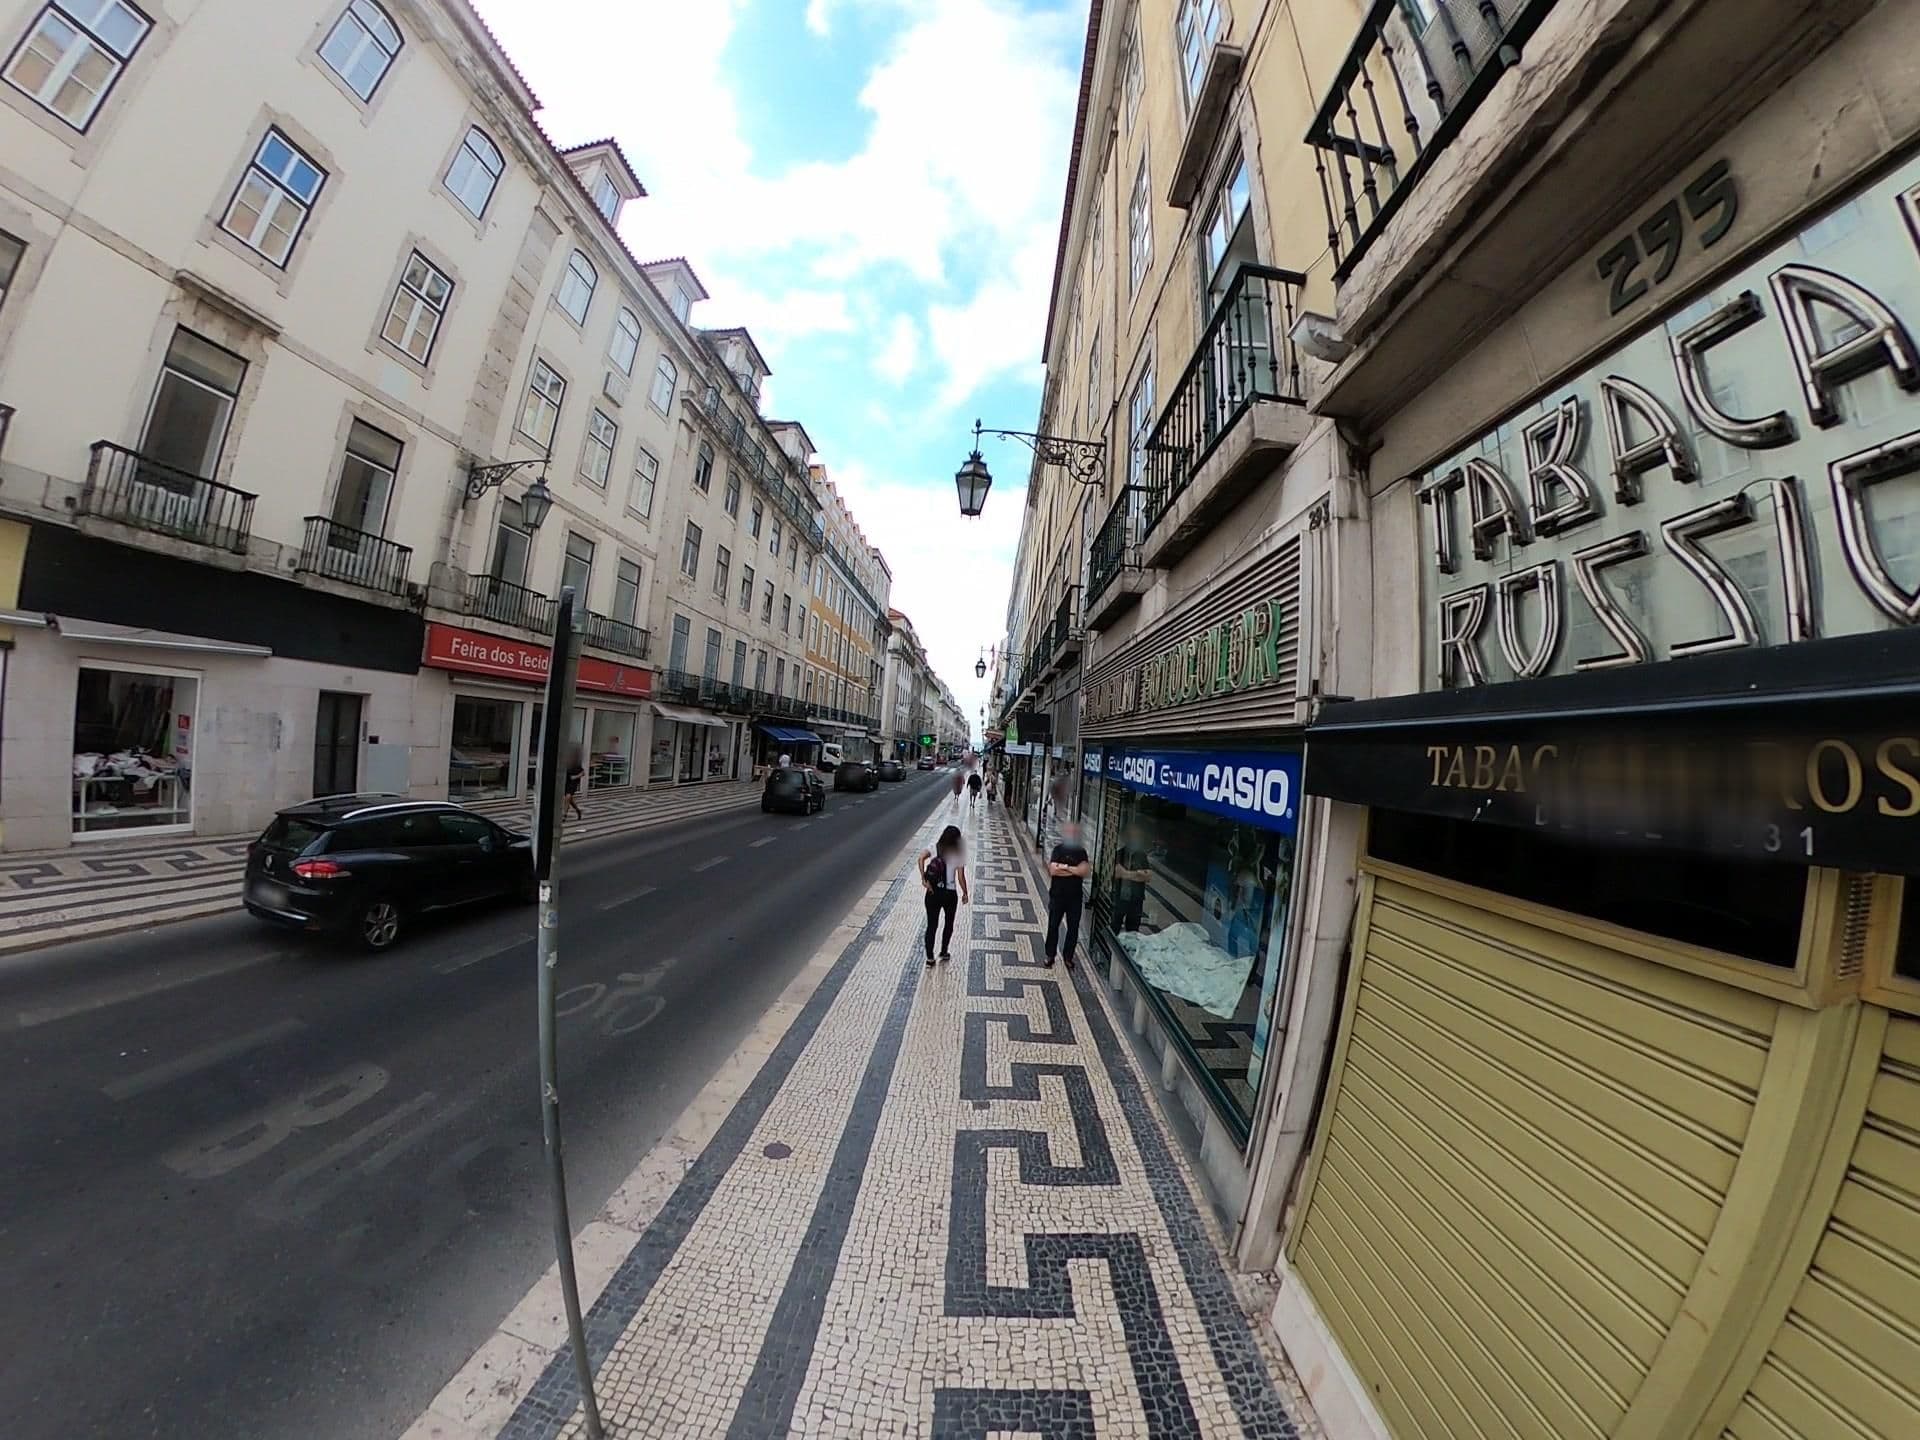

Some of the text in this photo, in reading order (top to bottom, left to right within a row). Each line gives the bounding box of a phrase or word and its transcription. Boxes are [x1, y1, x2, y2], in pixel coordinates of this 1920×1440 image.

[1597, 159, 1738, 316] 295
[1420, 183, 1920, 575] TABACA
[451, 637, 487, 660] Feira
[491, 646, 514, 664] dos
[1083, 752, 1101, 773] CASIO
[1123, 757, 1155, 785] CASIO
[1203, 764, 1289, 816] CASIO
